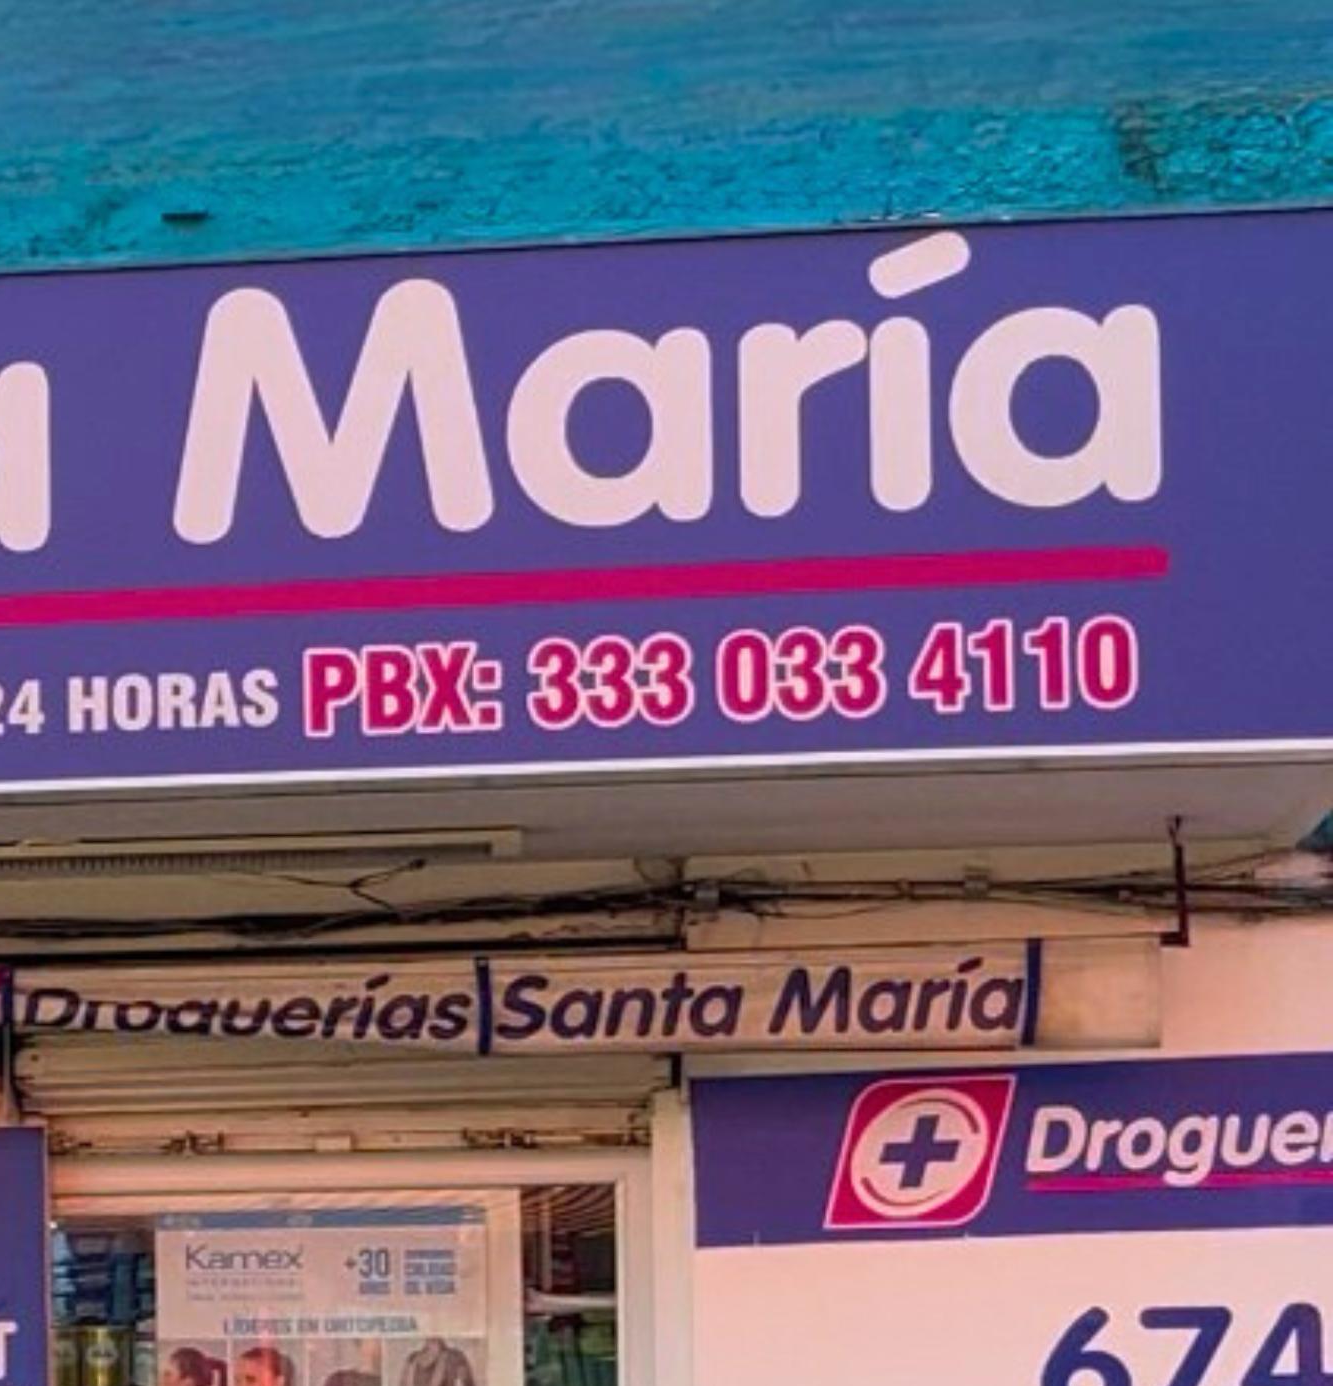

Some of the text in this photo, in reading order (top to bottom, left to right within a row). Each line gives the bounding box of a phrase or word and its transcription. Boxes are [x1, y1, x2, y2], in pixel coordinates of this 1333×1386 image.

[172, 231, 1161, 544] María
[67, 669, 278, 731] HORAS
[302, 642, 500, 739] PBX:
[528, 633, 692, 727] 333
[719, 627, 880, 719] 033
[911, 614, 1138, 712] 4110
[495, 971, 742, 1038] Santa
[768, 957, 1025, 1033] María
